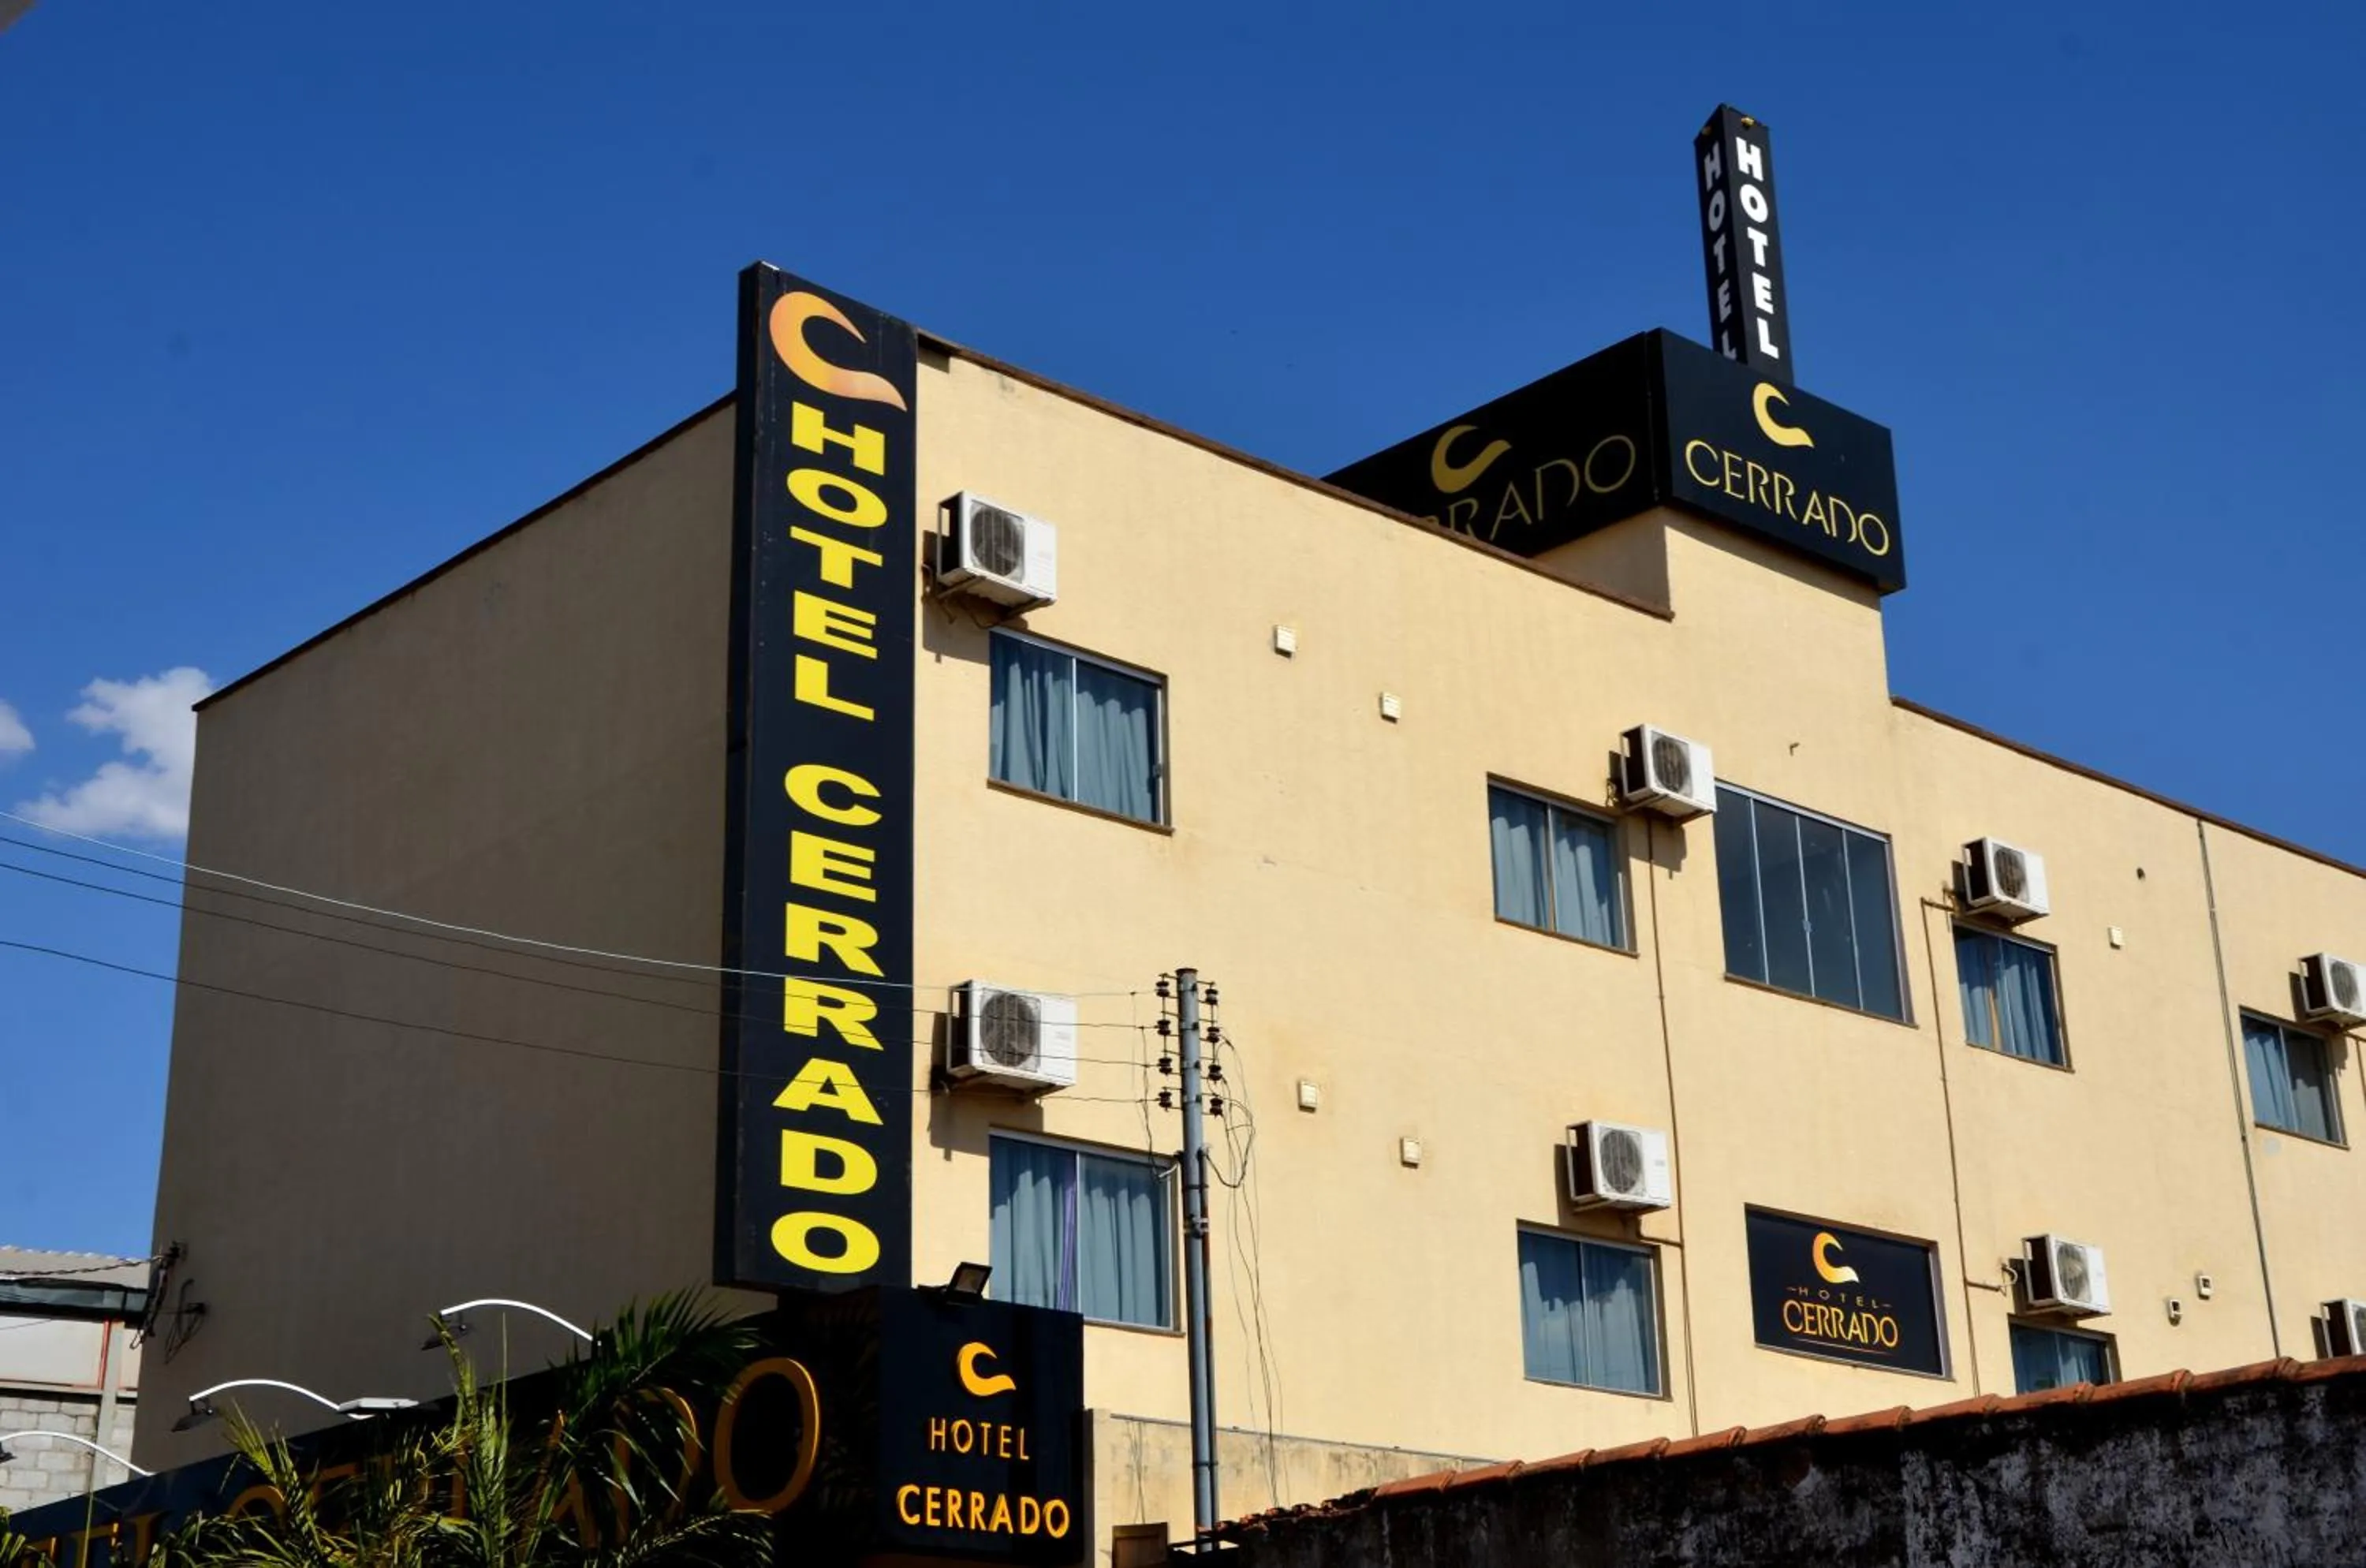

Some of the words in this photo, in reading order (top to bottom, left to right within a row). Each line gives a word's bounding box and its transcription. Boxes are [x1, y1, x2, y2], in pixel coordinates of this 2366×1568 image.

[1704, 141, 1737, 360] HOTEL
[1736, 136, 1779, 360] HOTEL
[1424, 434, 1636, 542] RADO
[1685, 439, 1890, 556] CERRADO
[787, 401, 888, 722] HOTEL
[771, 764, 884, 1274] CERRADO
[1782, 1299, 1899, 1348] CERRADO
[1798, 1286, 1879, 1309] HOTEL
[930, 1417, 1030, 1460] HOTEL
[896, 1484, 1071, 1539] CERRADO
